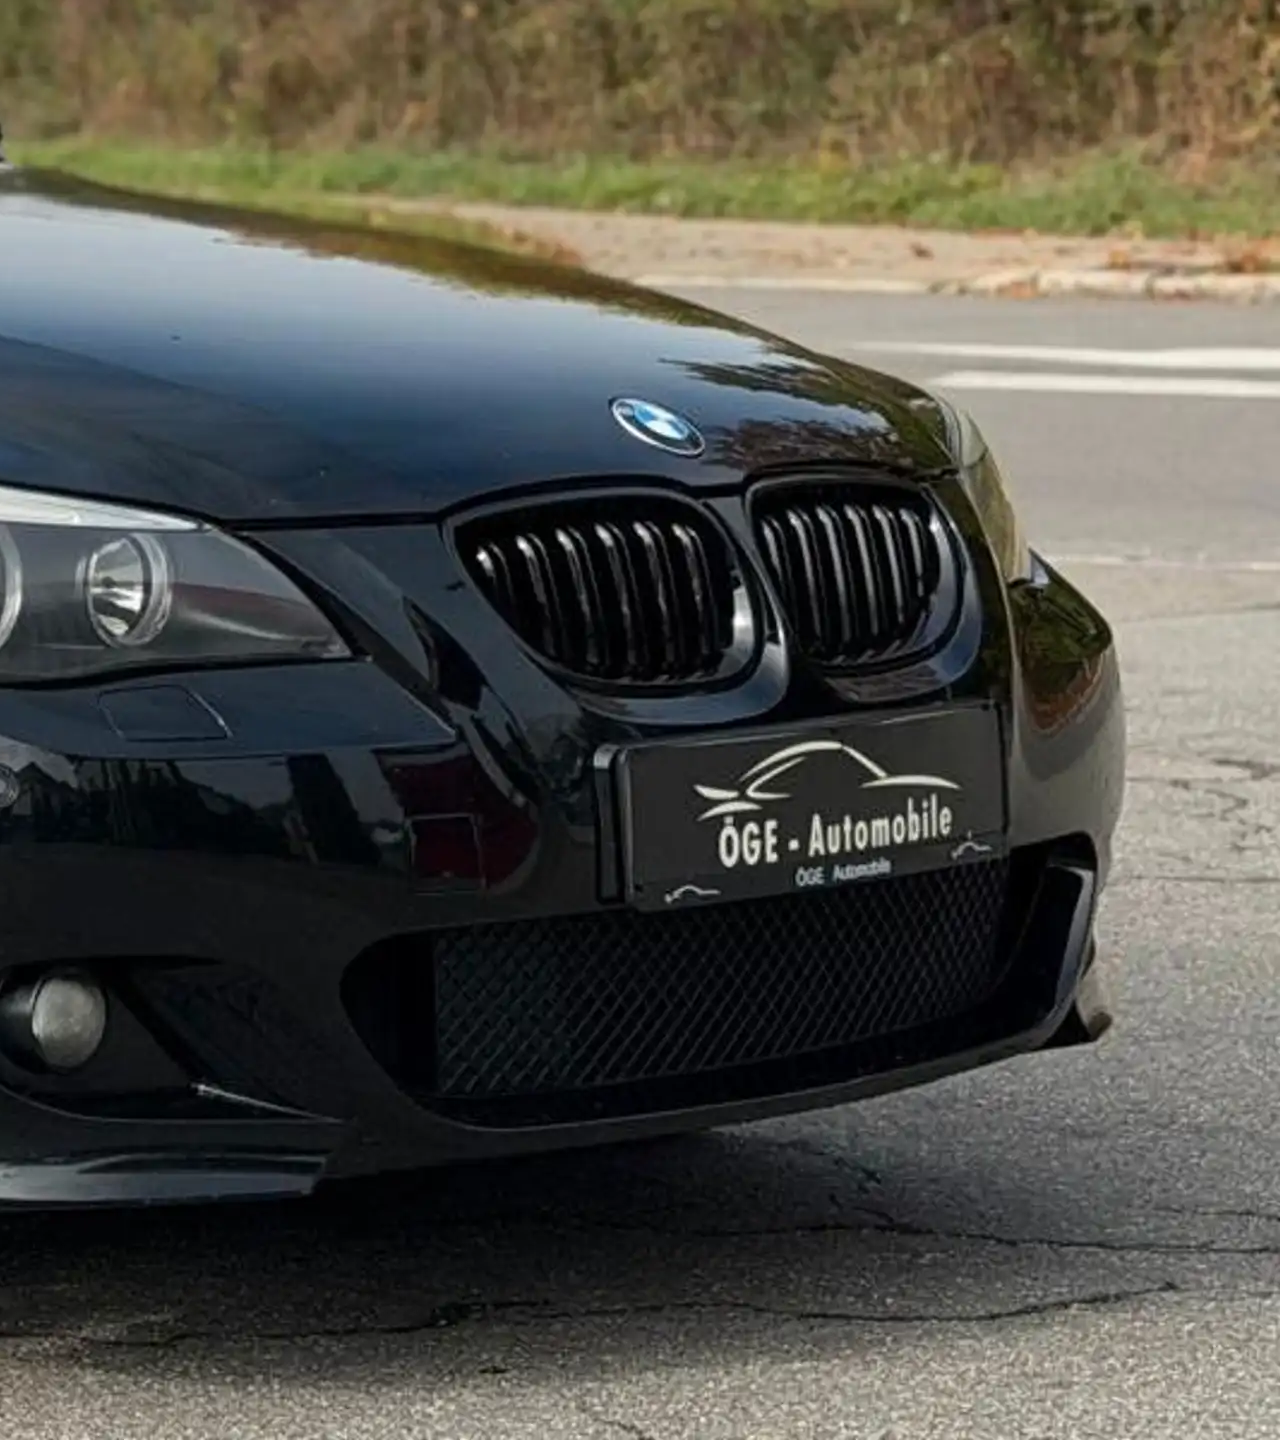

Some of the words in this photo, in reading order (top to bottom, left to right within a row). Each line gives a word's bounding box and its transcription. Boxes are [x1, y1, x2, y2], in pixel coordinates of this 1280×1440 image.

[718, 815, 779, 868] ÖGE
[808, 793, 953, 858] Automobile
[795, 865, 825, 887] ÖGE
[833, 856, 892, 881] Automobile
